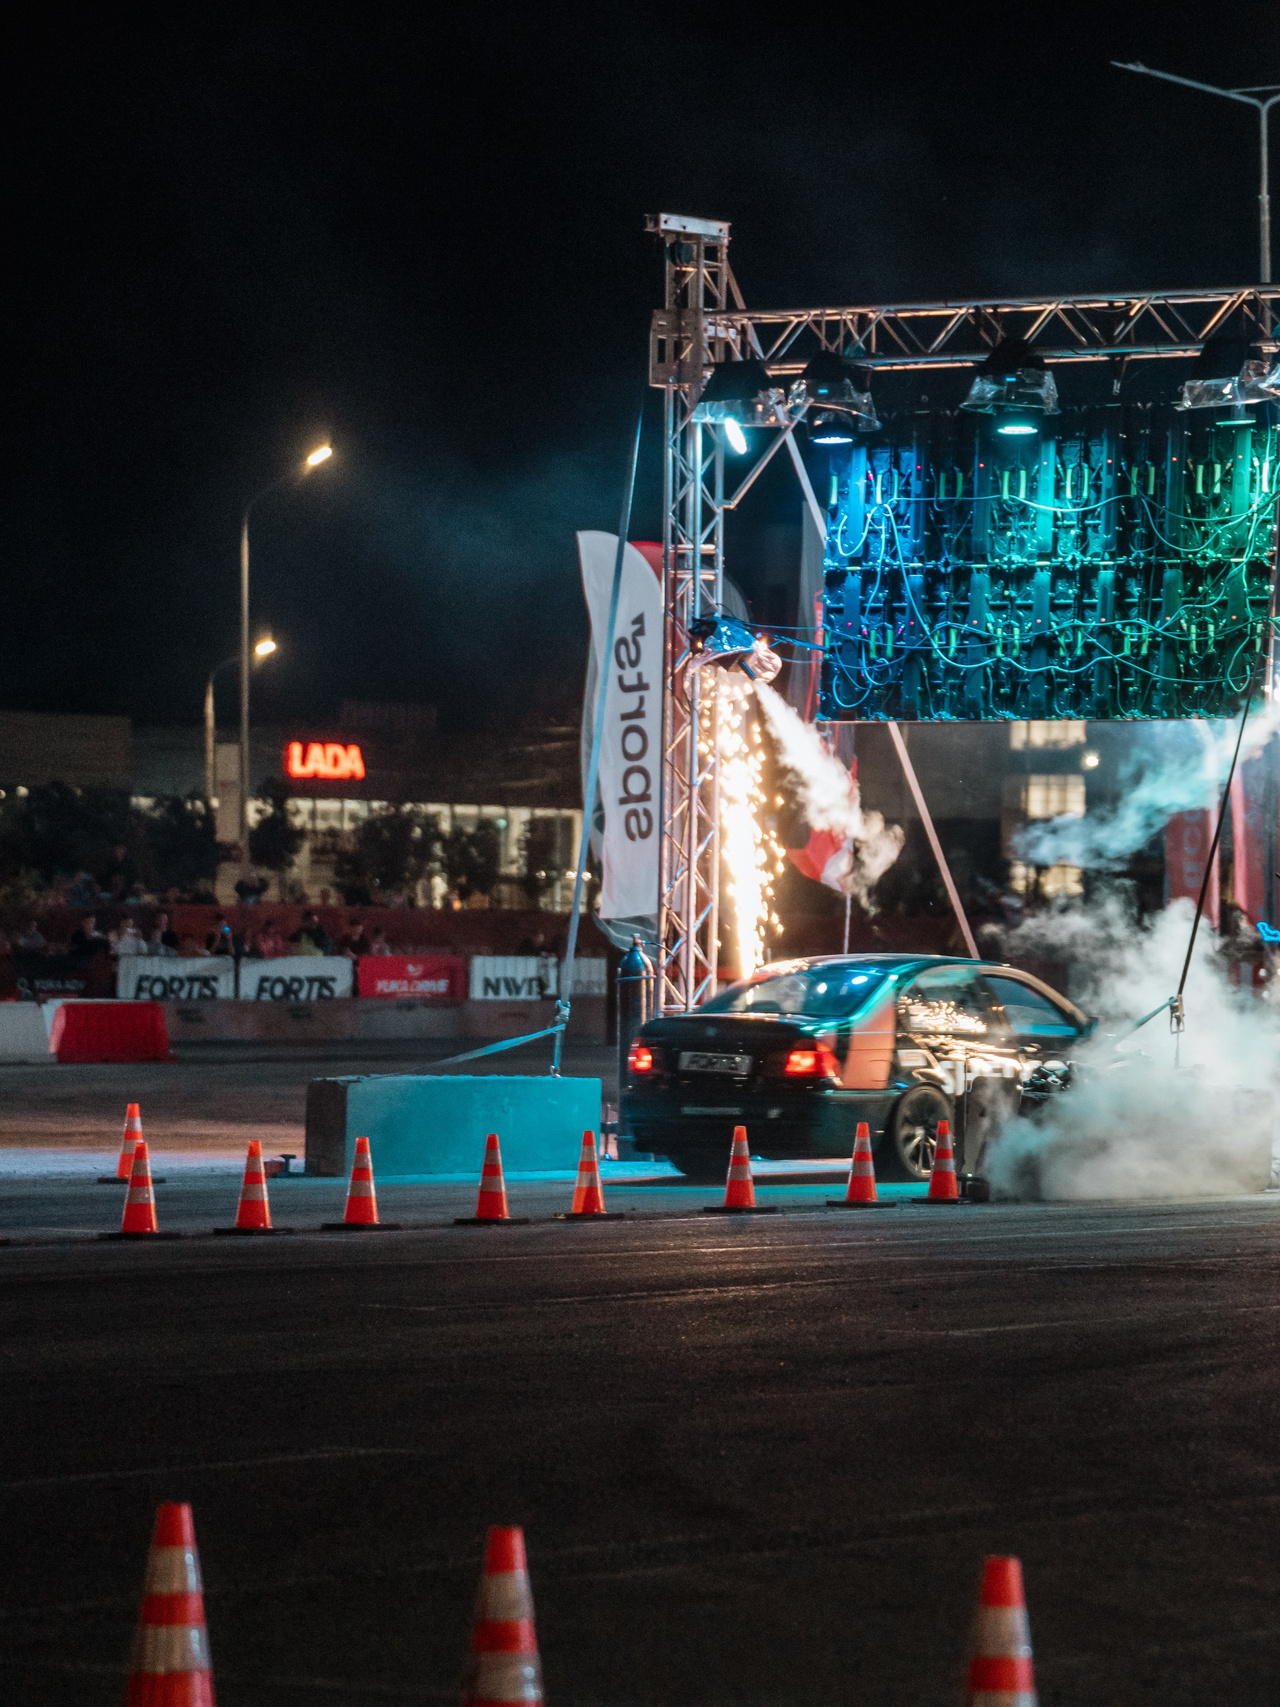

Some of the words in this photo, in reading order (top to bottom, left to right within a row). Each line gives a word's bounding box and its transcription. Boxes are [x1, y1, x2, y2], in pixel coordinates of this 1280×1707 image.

[285, 741, 365, 779] LADA
[135, 974, 218, 1000] FORTIS
[256, 975, 337, 1000] FORTIS
